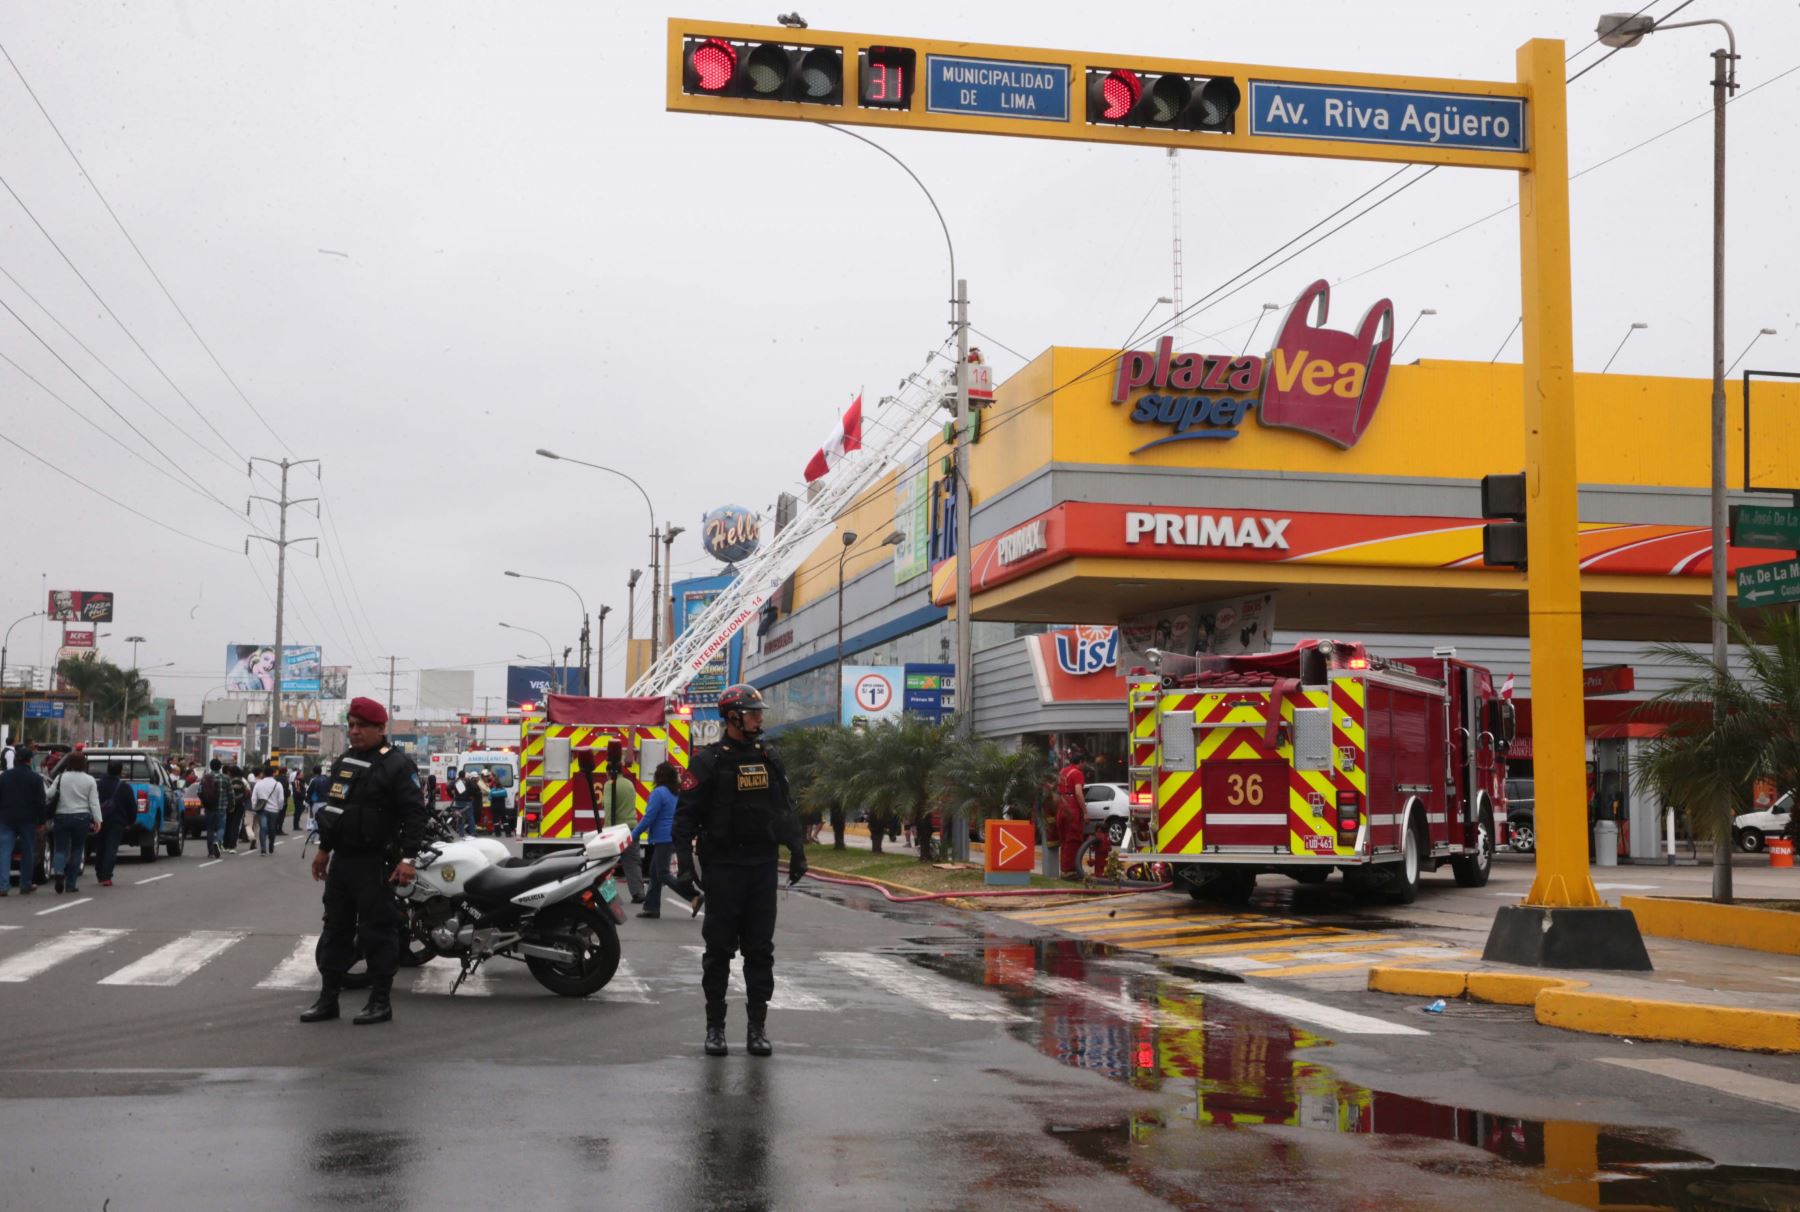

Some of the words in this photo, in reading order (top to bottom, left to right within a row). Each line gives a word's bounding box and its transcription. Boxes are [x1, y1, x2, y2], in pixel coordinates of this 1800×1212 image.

[872, 62, 903, 101] 31
[943, 66, 1054, 90] MUNICIPALIDAD
[960, 89, 978, 105] DE
[1001, 92, 1036, 110] LIMA
[1266, 95, 1308, 125] Av.
[1325, 98, 1390, 130] Riva
[1400, 104, 1510, 143] Agüero
[972, 367, 988, 385] 14
[1112, 336, 1263, 404] plaza
[1274, 348, 1367, 399] Vea
[1130, 393, 1260, 433] super
[706, 512, 760, 551] Hello
[1126, 511, 1292, 549] PRIMAX
[1751, 510, 1773, 526] José
[1774, 511, 1785, 526] De
[998, 519, 1048, 567] PRIMAX
[1739, 572, 1755, 587] Av.
[1757, 568, 1771, 584] De
[1773, 565, 1787, 580] La
[691, 609, 752, 671] INTERNACIONAL
[752, 595, 763, 607] 14
[869, 688, 876, 705] 1
[739, 774, 768, 789] POLICIA
[1226, 773, 1264, 807] 36
[517, 893, 546, 904] POLICIA
